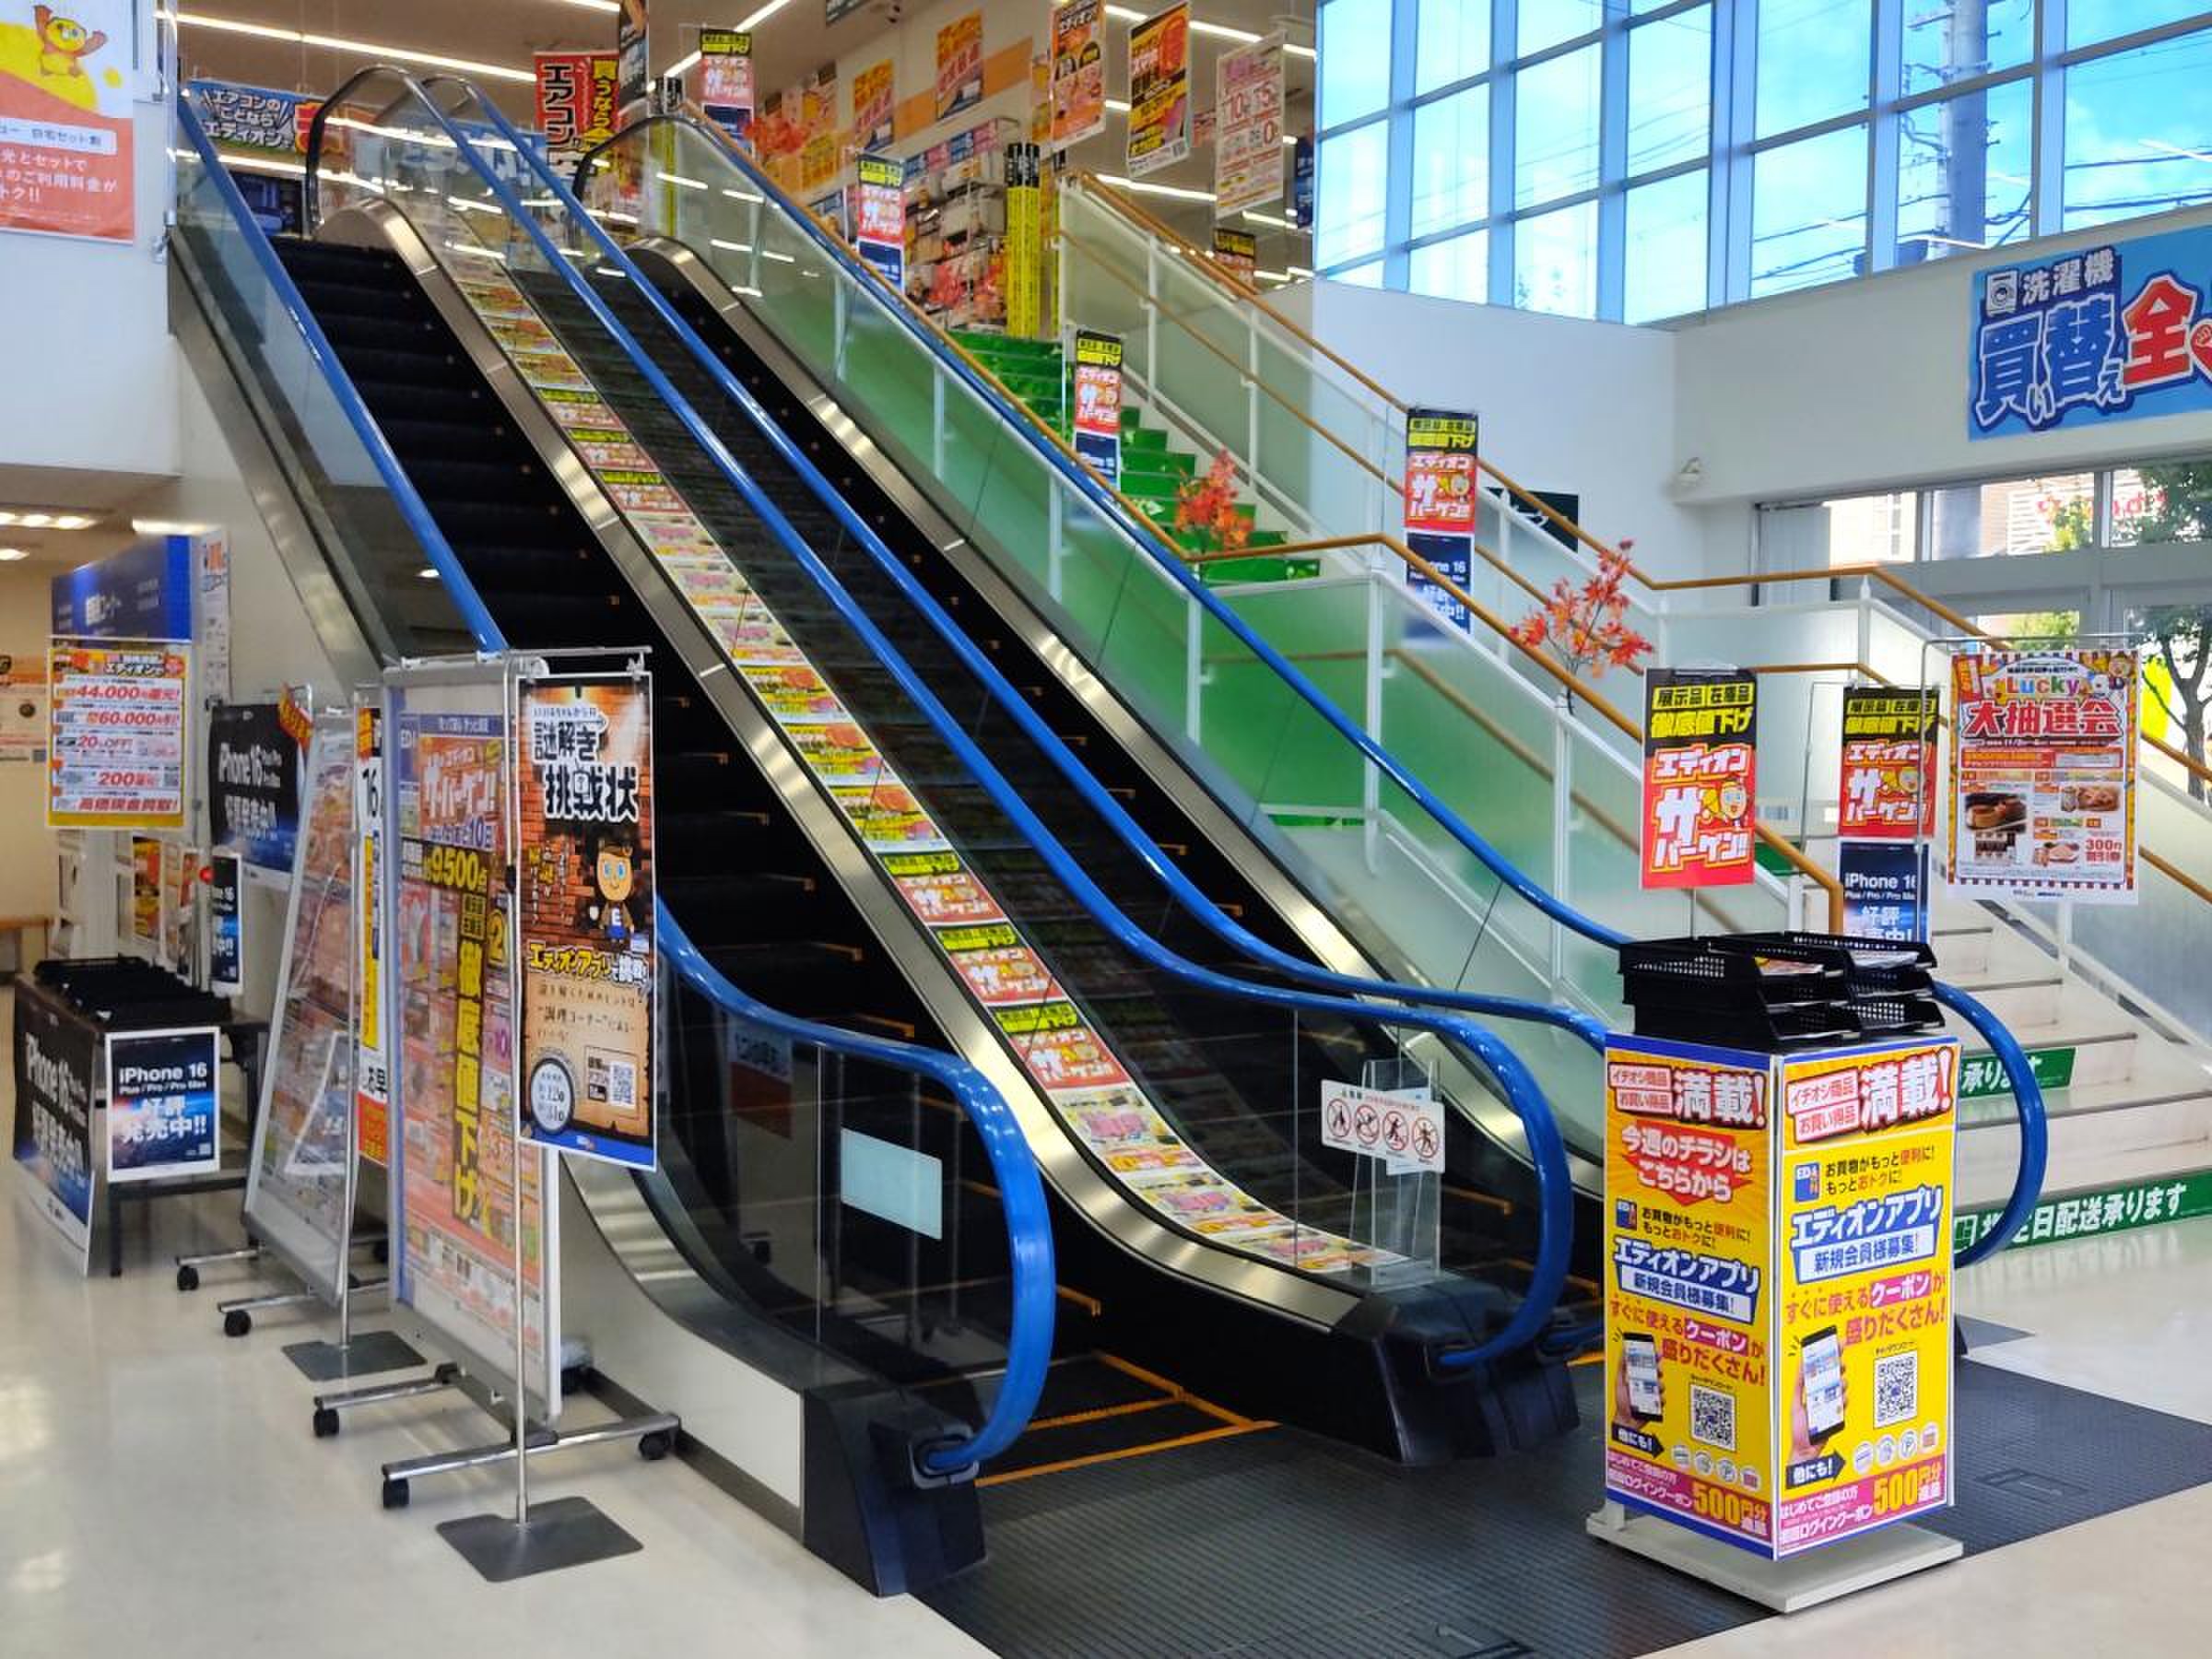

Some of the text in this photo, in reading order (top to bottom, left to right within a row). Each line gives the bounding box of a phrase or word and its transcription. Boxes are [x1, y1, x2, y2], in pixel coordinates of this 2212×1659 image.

[544, 64, 576, 150] エアコン
[0, 169, 118, 193] のご利用料金が
[2022, 249, 2114, 305] 洗濯機
[534, 722, 597, 760] 謎解き
[1964, 699, 2120, 736] 大抽選会
[1657, 747, 1746, 777] エディオン
[545, 764, 638, 819] 挑戦状
[1845, 872, 1898, 889] iPhone
[119, 1062, 207, 1084] iPhone 16
[1861, 1049, 1952, 1126] 満載!
[1674, 1069, 1766, 1126] 満載!
[1622, 1124, 1751, 1173] 今週のチラシは
[1825, 1146, 1935, 1178] お買物がもっと便利に!
[1638, 1159, 1732, 1202] こちらから
[1792, 1187, 1942, 1248] エディオンアプリ
[1614, 1237, 1759, 1292] エディオンアプリ
[1815, 1232, 1918, 1272] 新規会員様募集!
[1844, 1298, 1947, 1346] 盛りだくさん!
[1662, 1338, 1765, 1386] 盛りだくさん!
